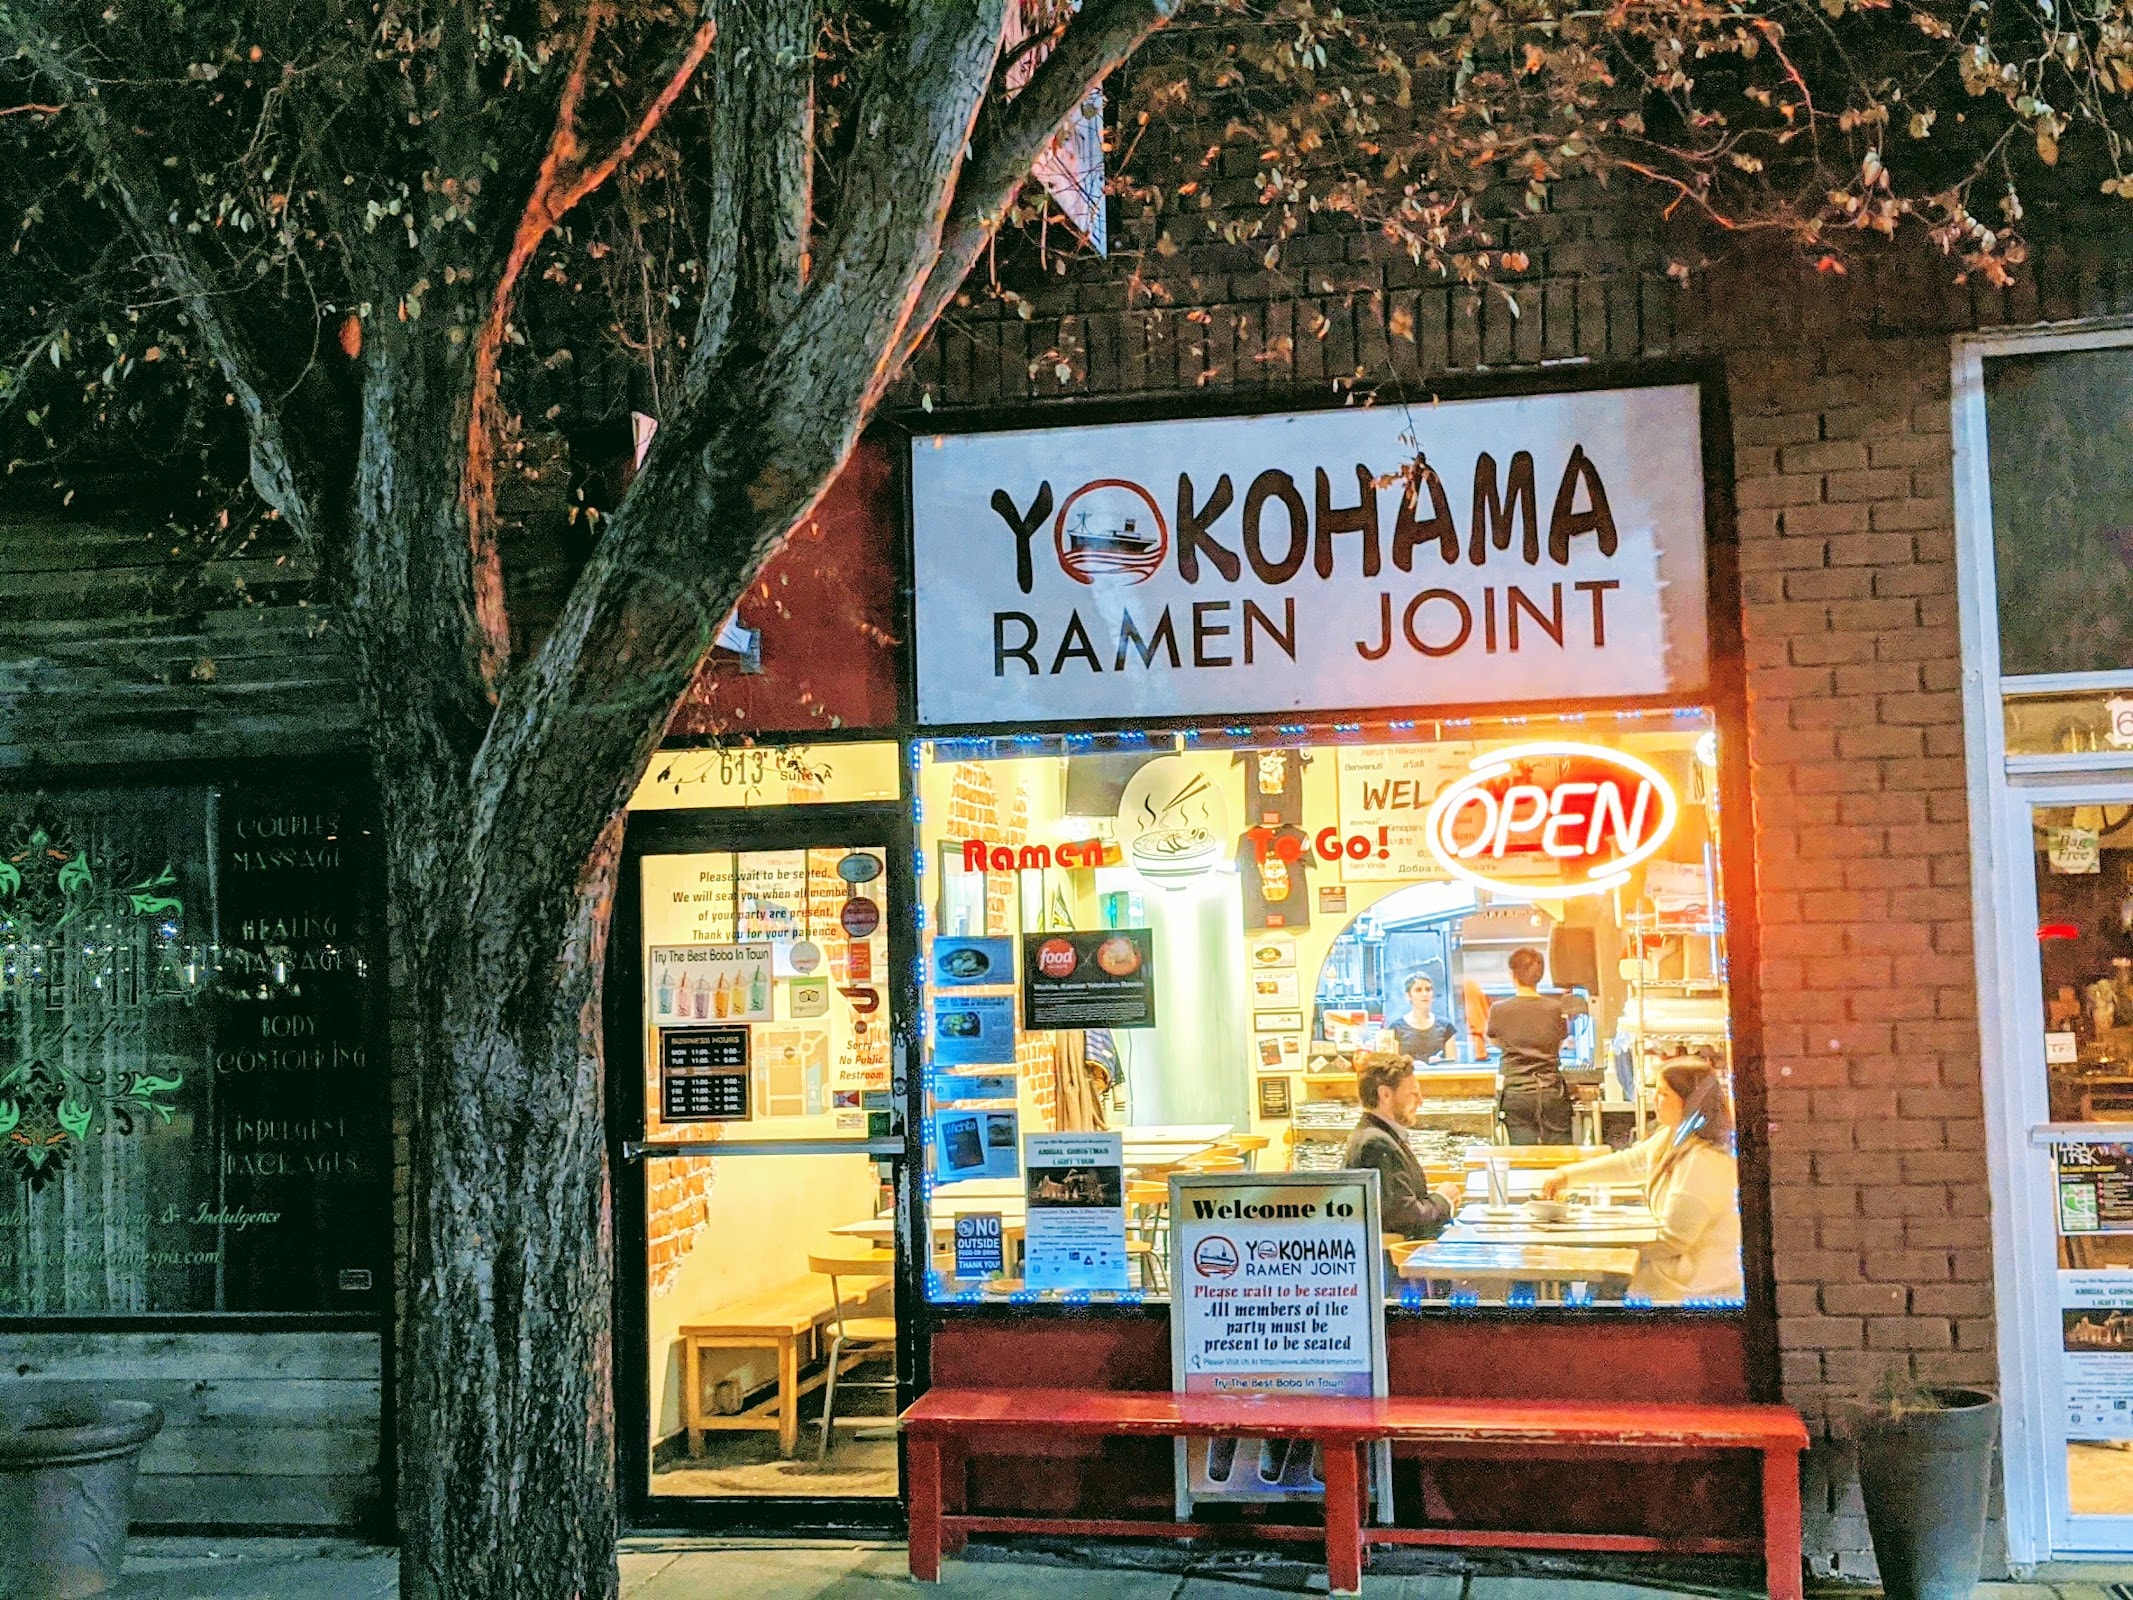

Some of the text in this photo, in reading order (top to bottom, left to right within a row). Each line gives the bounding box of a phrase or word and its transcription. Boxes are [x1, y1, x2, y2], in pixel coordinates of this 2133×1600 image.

[991, 444, 1618, 594] YOKOHAMA
[995, 580, 1620, 678] RAMEN JOINT
[721, 752, 763, 785] 613
[780, 768, 814, 781] Suite
[237, 815, 340, 838] COUPLES
[1442, 780, 1651, 859] OPEN
[963, 826, 1390, 872] Ramen To Go!
[233, 848, 341, 871] MASSAGE
[700, 872, 733, 882] Please
[738, 870, 759, 880] wait
[763, 870, 773, 879] to
[777, 869, 789, 879] be
[673, 892, 689, 902] We
[693, 891, 712, 901] will
[716, 891, 737, 901] seat
[741, 891, 759, 902] you
[763, 889, 791, 899] when
[794, 888, 806, 898] all
[699, 908, 833, 923] of your party are present.
[242, 910, 337, 940] HEALING
[693, 930, 722, 941] Thank
[726, 931, 743, 942] you
[747, 929, 762, 939] for
[766, 929, 789, 941] your
[654, 947, 768, 965] Try The Best Boba In Town
[1039, 947, 1074, 971] food
[262, 1015, 316, 1037] BODY
[216, 1041, 366, 1073] CONTOURING
[840, 1055, 883, 1065] No Public
[840, 1070, 884, 1080] Restroom
[189, 1202, 281, 1231] Indulgence
[1193, 1200, 1354, 1219] Welcome to
[976, 1218, 999, 1236] NO
[958, 1238, 1000, 1248] OUTSIDE
[1246, 1239, 1356, 1261] YOKOHAMA
[958, 1260, 983, 1269] THANK
[1246, 1262, 1356, 1276] RAMEN JOINT
[1194, 1284, 1358, 1298] Please wait to be seated
[1204, 1301, 1349, 1317] All members of the
[1227, 1318, 1328, 1337] party must be
[1204, 1336, 1351, 1353] present to be seated
[1204, 1358, 1224, 1366] Please
[1215, 1377, 1345, 1389] Try The Best Boba In Town
